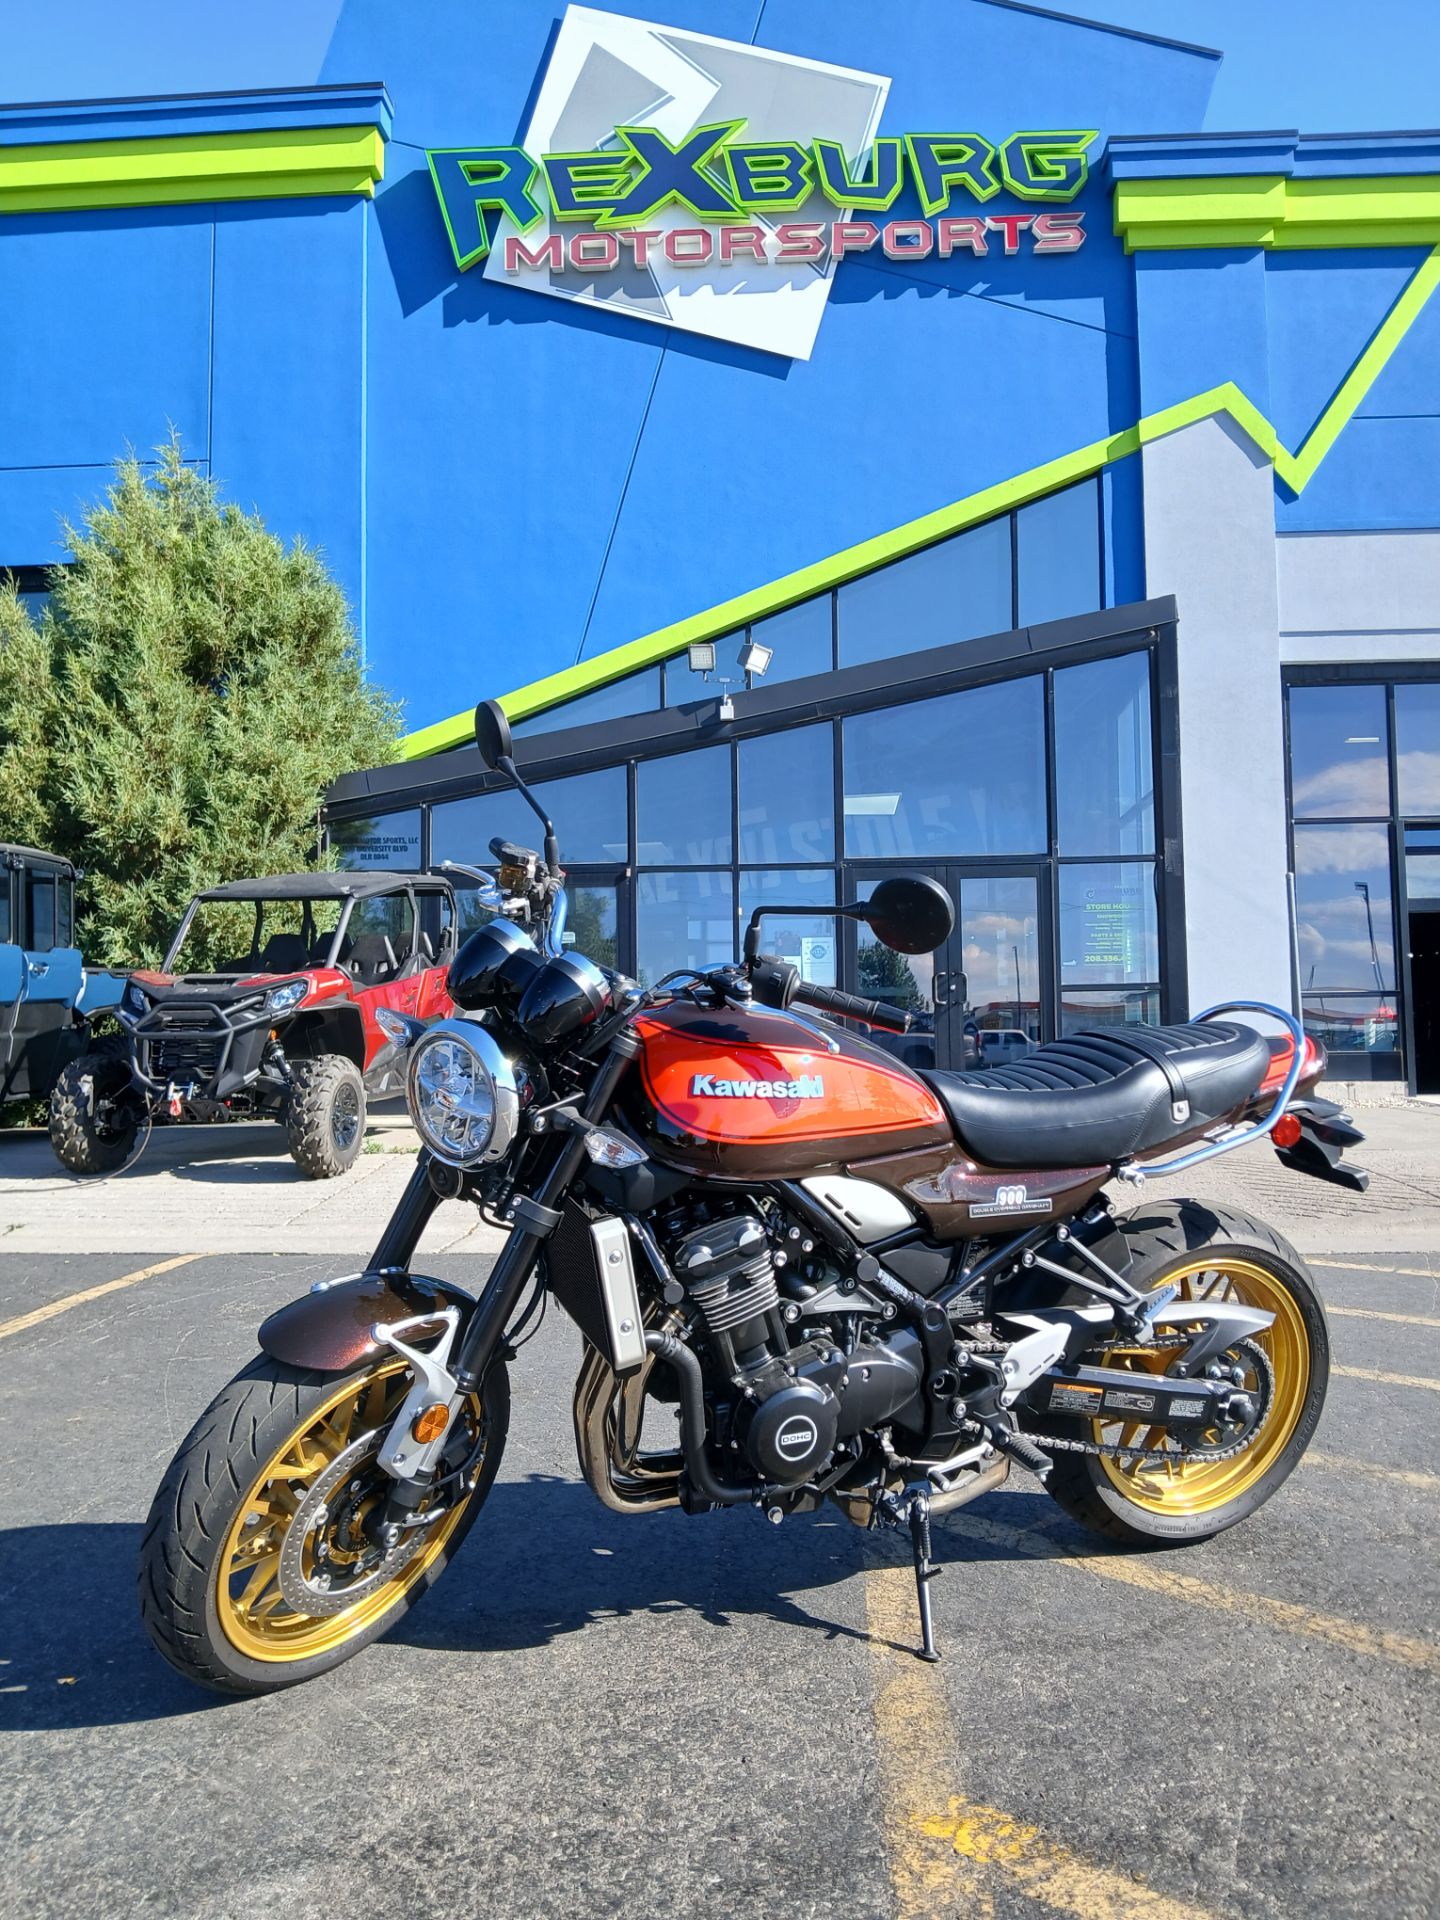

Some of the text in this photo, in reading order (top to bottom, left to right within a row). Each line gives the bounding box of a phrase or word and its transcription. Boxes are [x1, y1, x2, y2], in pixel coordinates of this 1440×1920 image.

[426, 118, 1100, 272] REXBURG
[504, 212, 1087, 277] MOTORSPORTS
[692, 1074, 825, 1099] Kawasaki
[999, 1190, 1024, 1206] 900
[782, 1433, 810, 1443] DOHC
